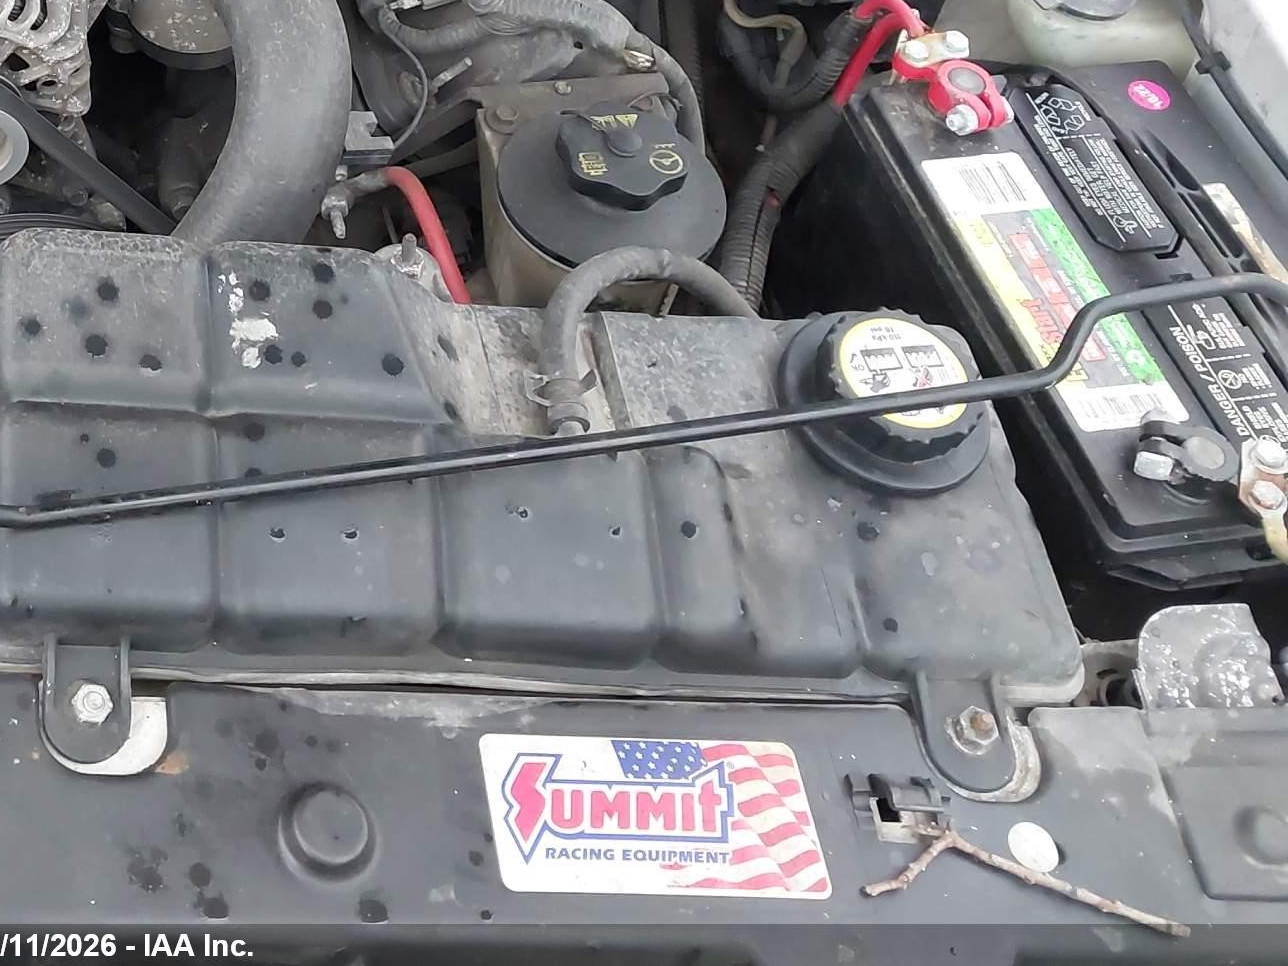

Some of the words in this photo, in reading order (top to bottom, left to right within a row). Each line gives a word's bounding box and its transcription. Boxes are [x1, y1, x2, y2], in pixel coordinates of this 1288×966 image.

[1090, 160, 1103, 173] FAST
[1099, 175, 1113, 188] HELP
[1168, 325, 1208, 371] POISON
[1206, 383, 1250, 435] DANGER
[545, 847, 616, 862] RACING
[621, 848, 730, 865] EQUIPMENT
